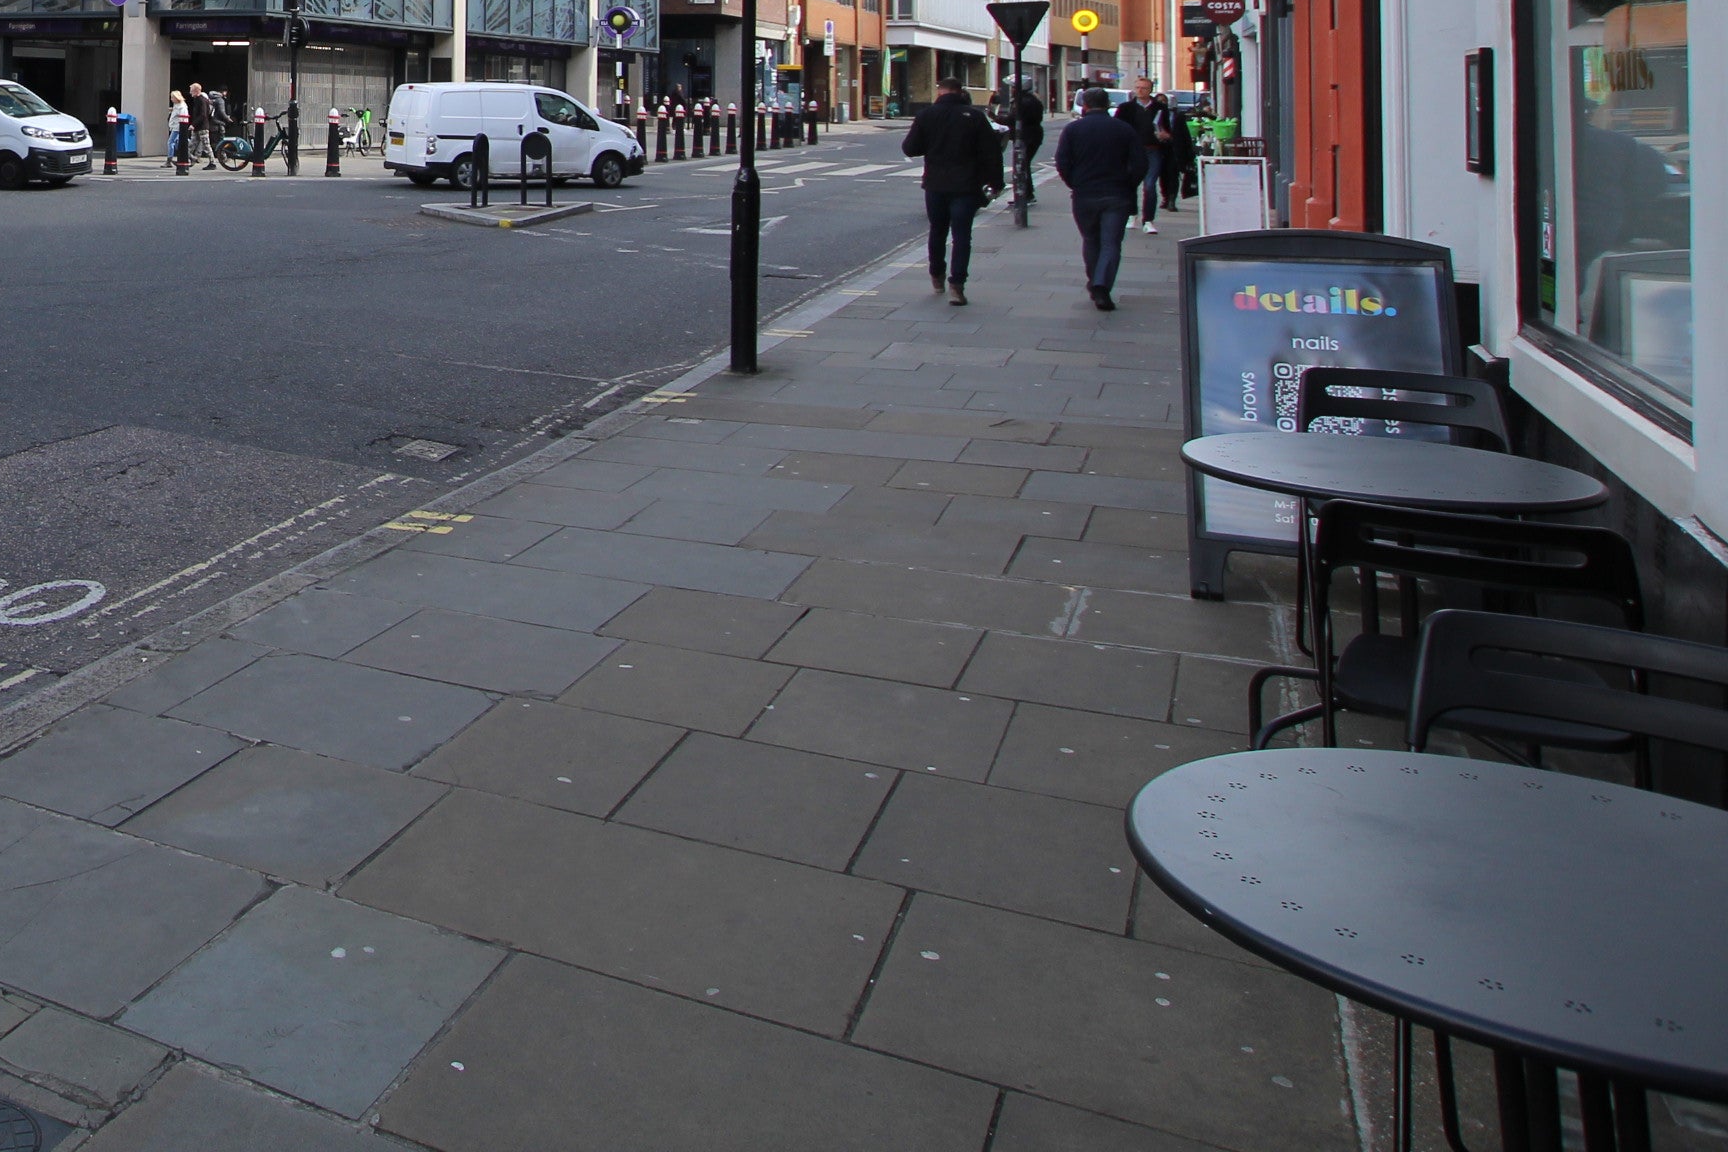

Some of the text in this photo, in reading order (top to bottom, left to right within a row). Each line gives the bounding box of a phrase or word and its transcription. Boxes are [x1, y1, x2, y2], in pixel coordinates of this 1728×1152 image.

[1207, 2, 1242, 10] COSTA
[175, 22, 208, 30] Farringdon
[1233, 284, 1397, 317] details.
[1292, 336, 1339, 350] nails
[1240, 371, 1257, 422] brows
[1274, 500, 1297, 509] M-F
[1275, 513, 1295, 524] Sat
